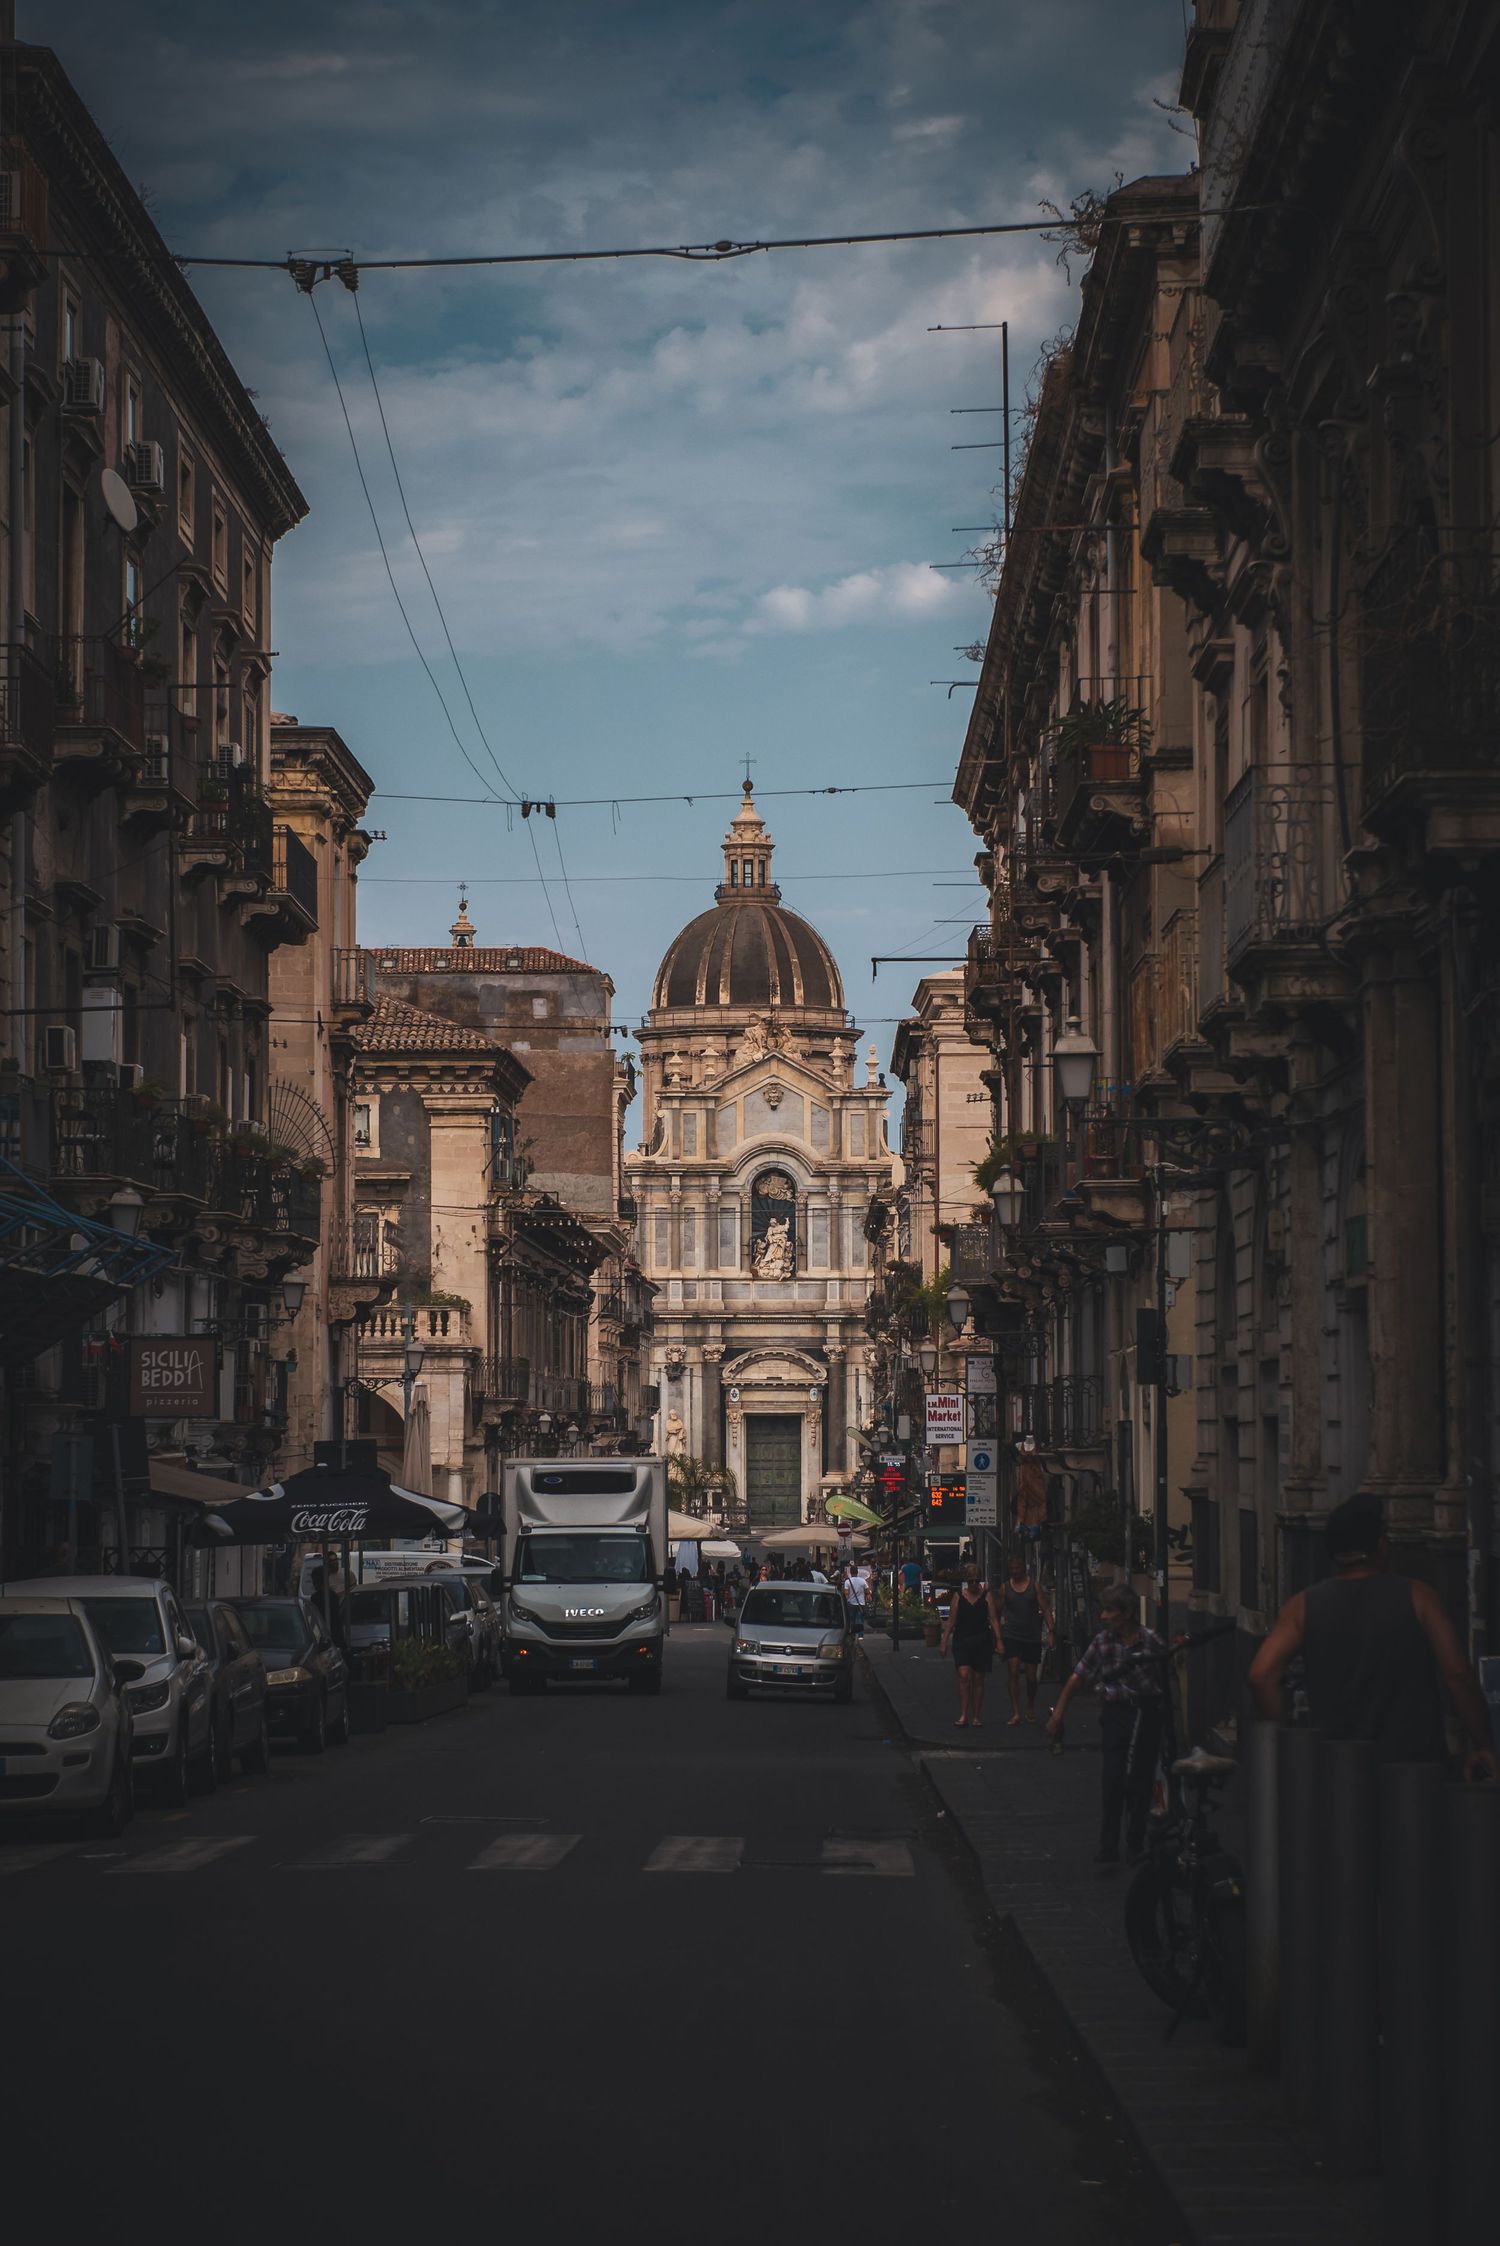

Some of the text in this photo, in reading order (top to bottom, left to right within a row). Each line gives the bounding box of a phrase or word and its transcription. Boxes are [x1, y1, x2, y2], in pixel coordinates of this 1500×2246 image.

[146, 1396, 199, 1408] pizzeria
[928, 1410, 961, 1422] Market
[291, 1508, 370, 1533] Coca-Cola
[565, 1608, 604, 1617] IVECO
